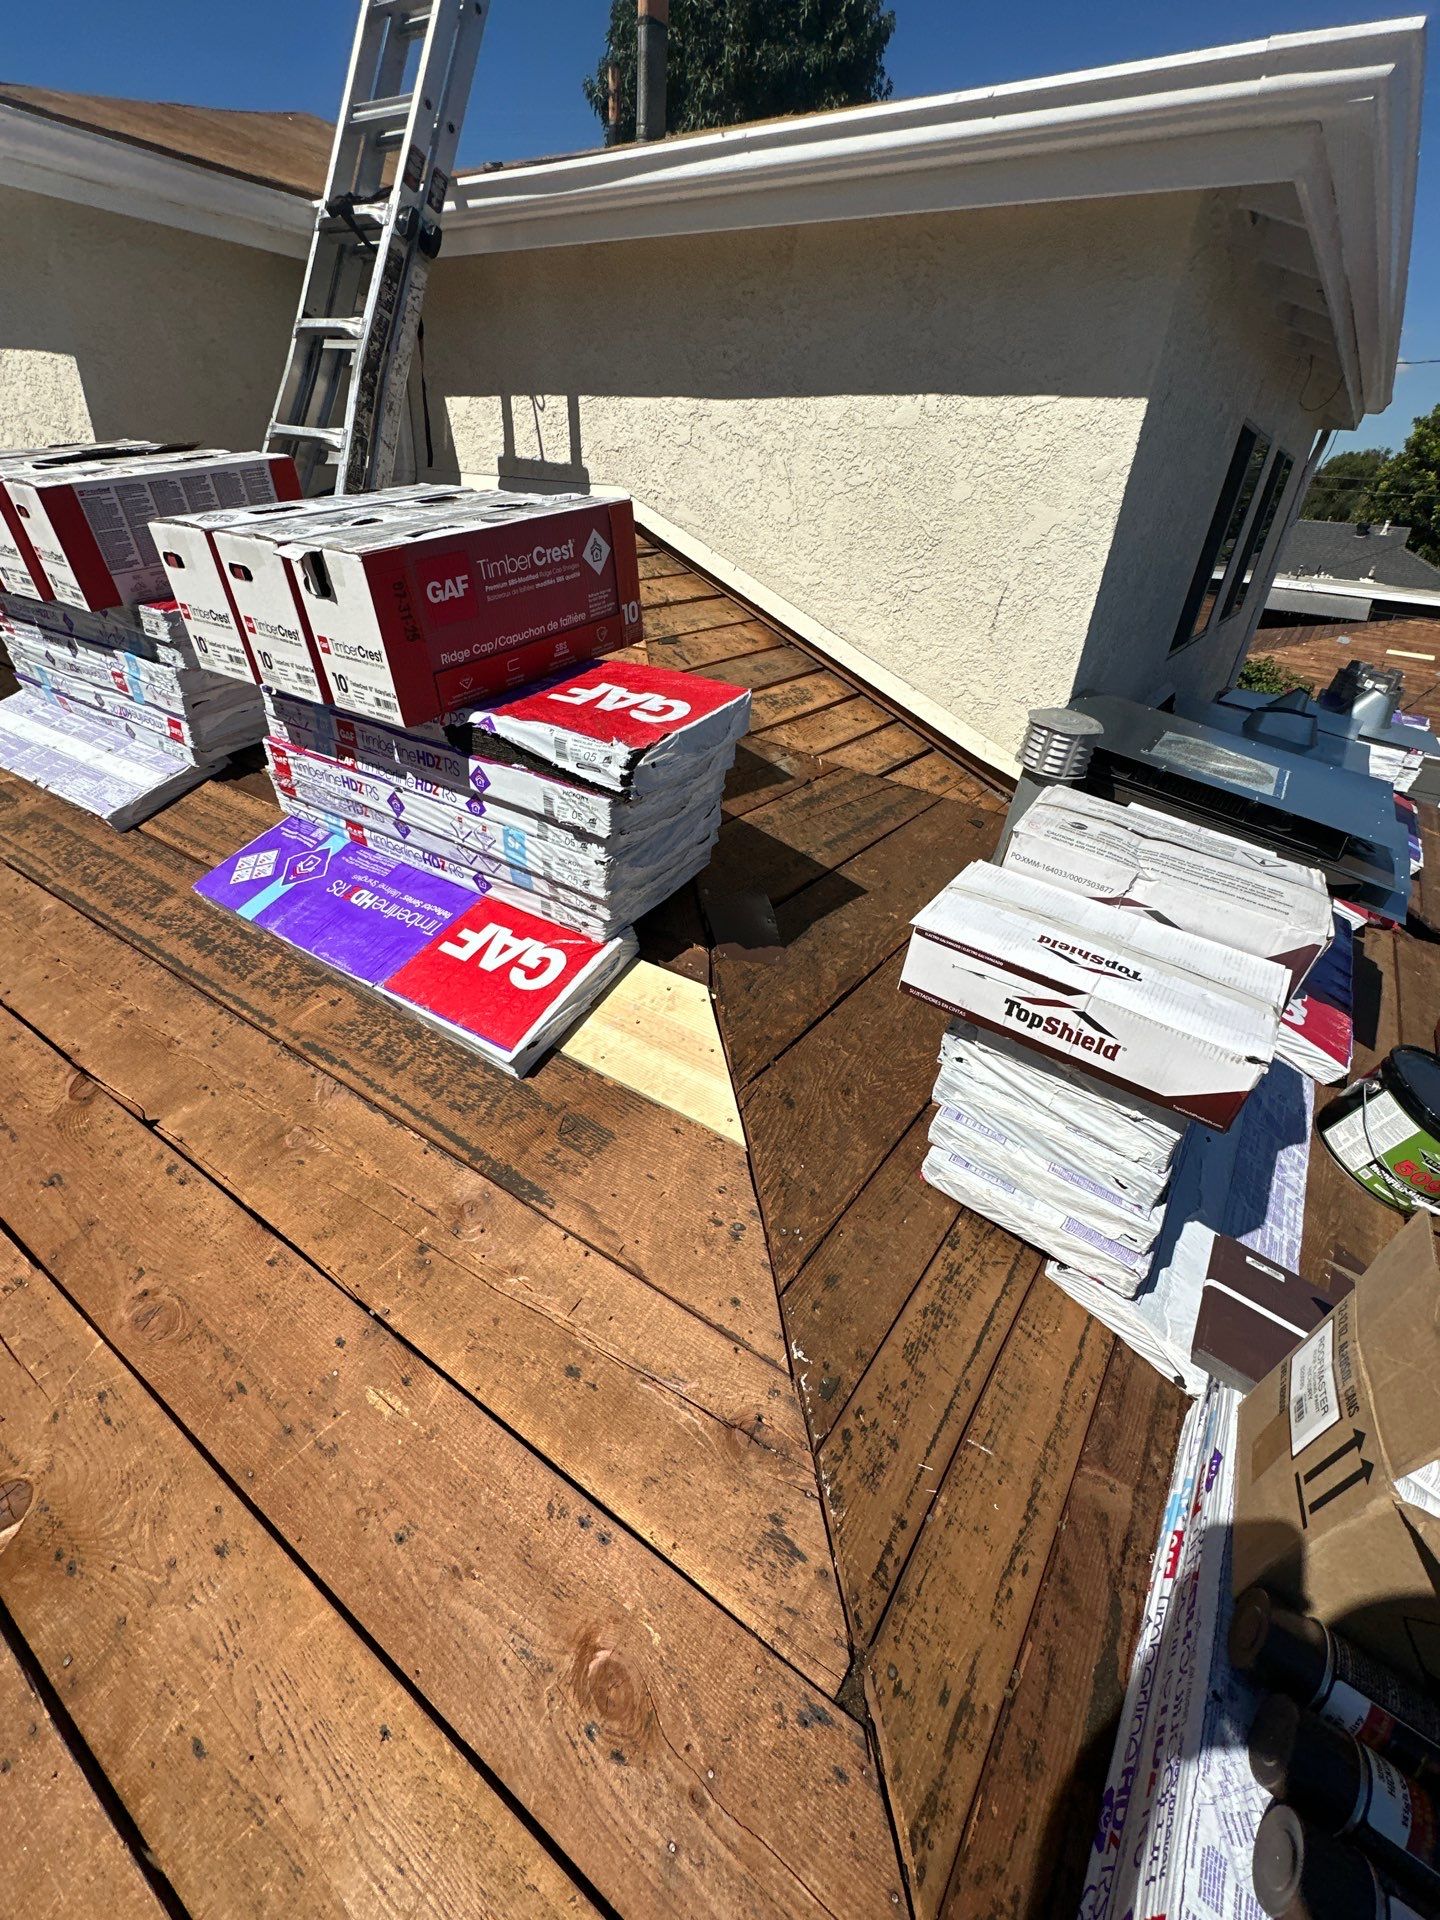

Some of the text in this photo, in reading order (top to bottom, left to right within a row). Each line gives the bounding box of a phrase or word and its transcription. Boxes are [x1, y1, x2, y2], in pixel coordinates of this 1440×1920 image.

[477, 538, 574, 580] TimberCrest
[426, 574, 469, 604] GAF
[329, 637, 383, 663] TimberCrest
[440, 648, 471, 665] Ridge
[547, 621, 559, 632] de
[547, 682, 691, 723] GAF
[343, 885, 443, 937] TimberlineHDZ
[437, 922, 568, 991] GAF
[1037, 934, 1142, 982] TopShield
[1004, 997, 1122, 1062] TopShield
[1344, 1385, 1360, 1418] CANS
